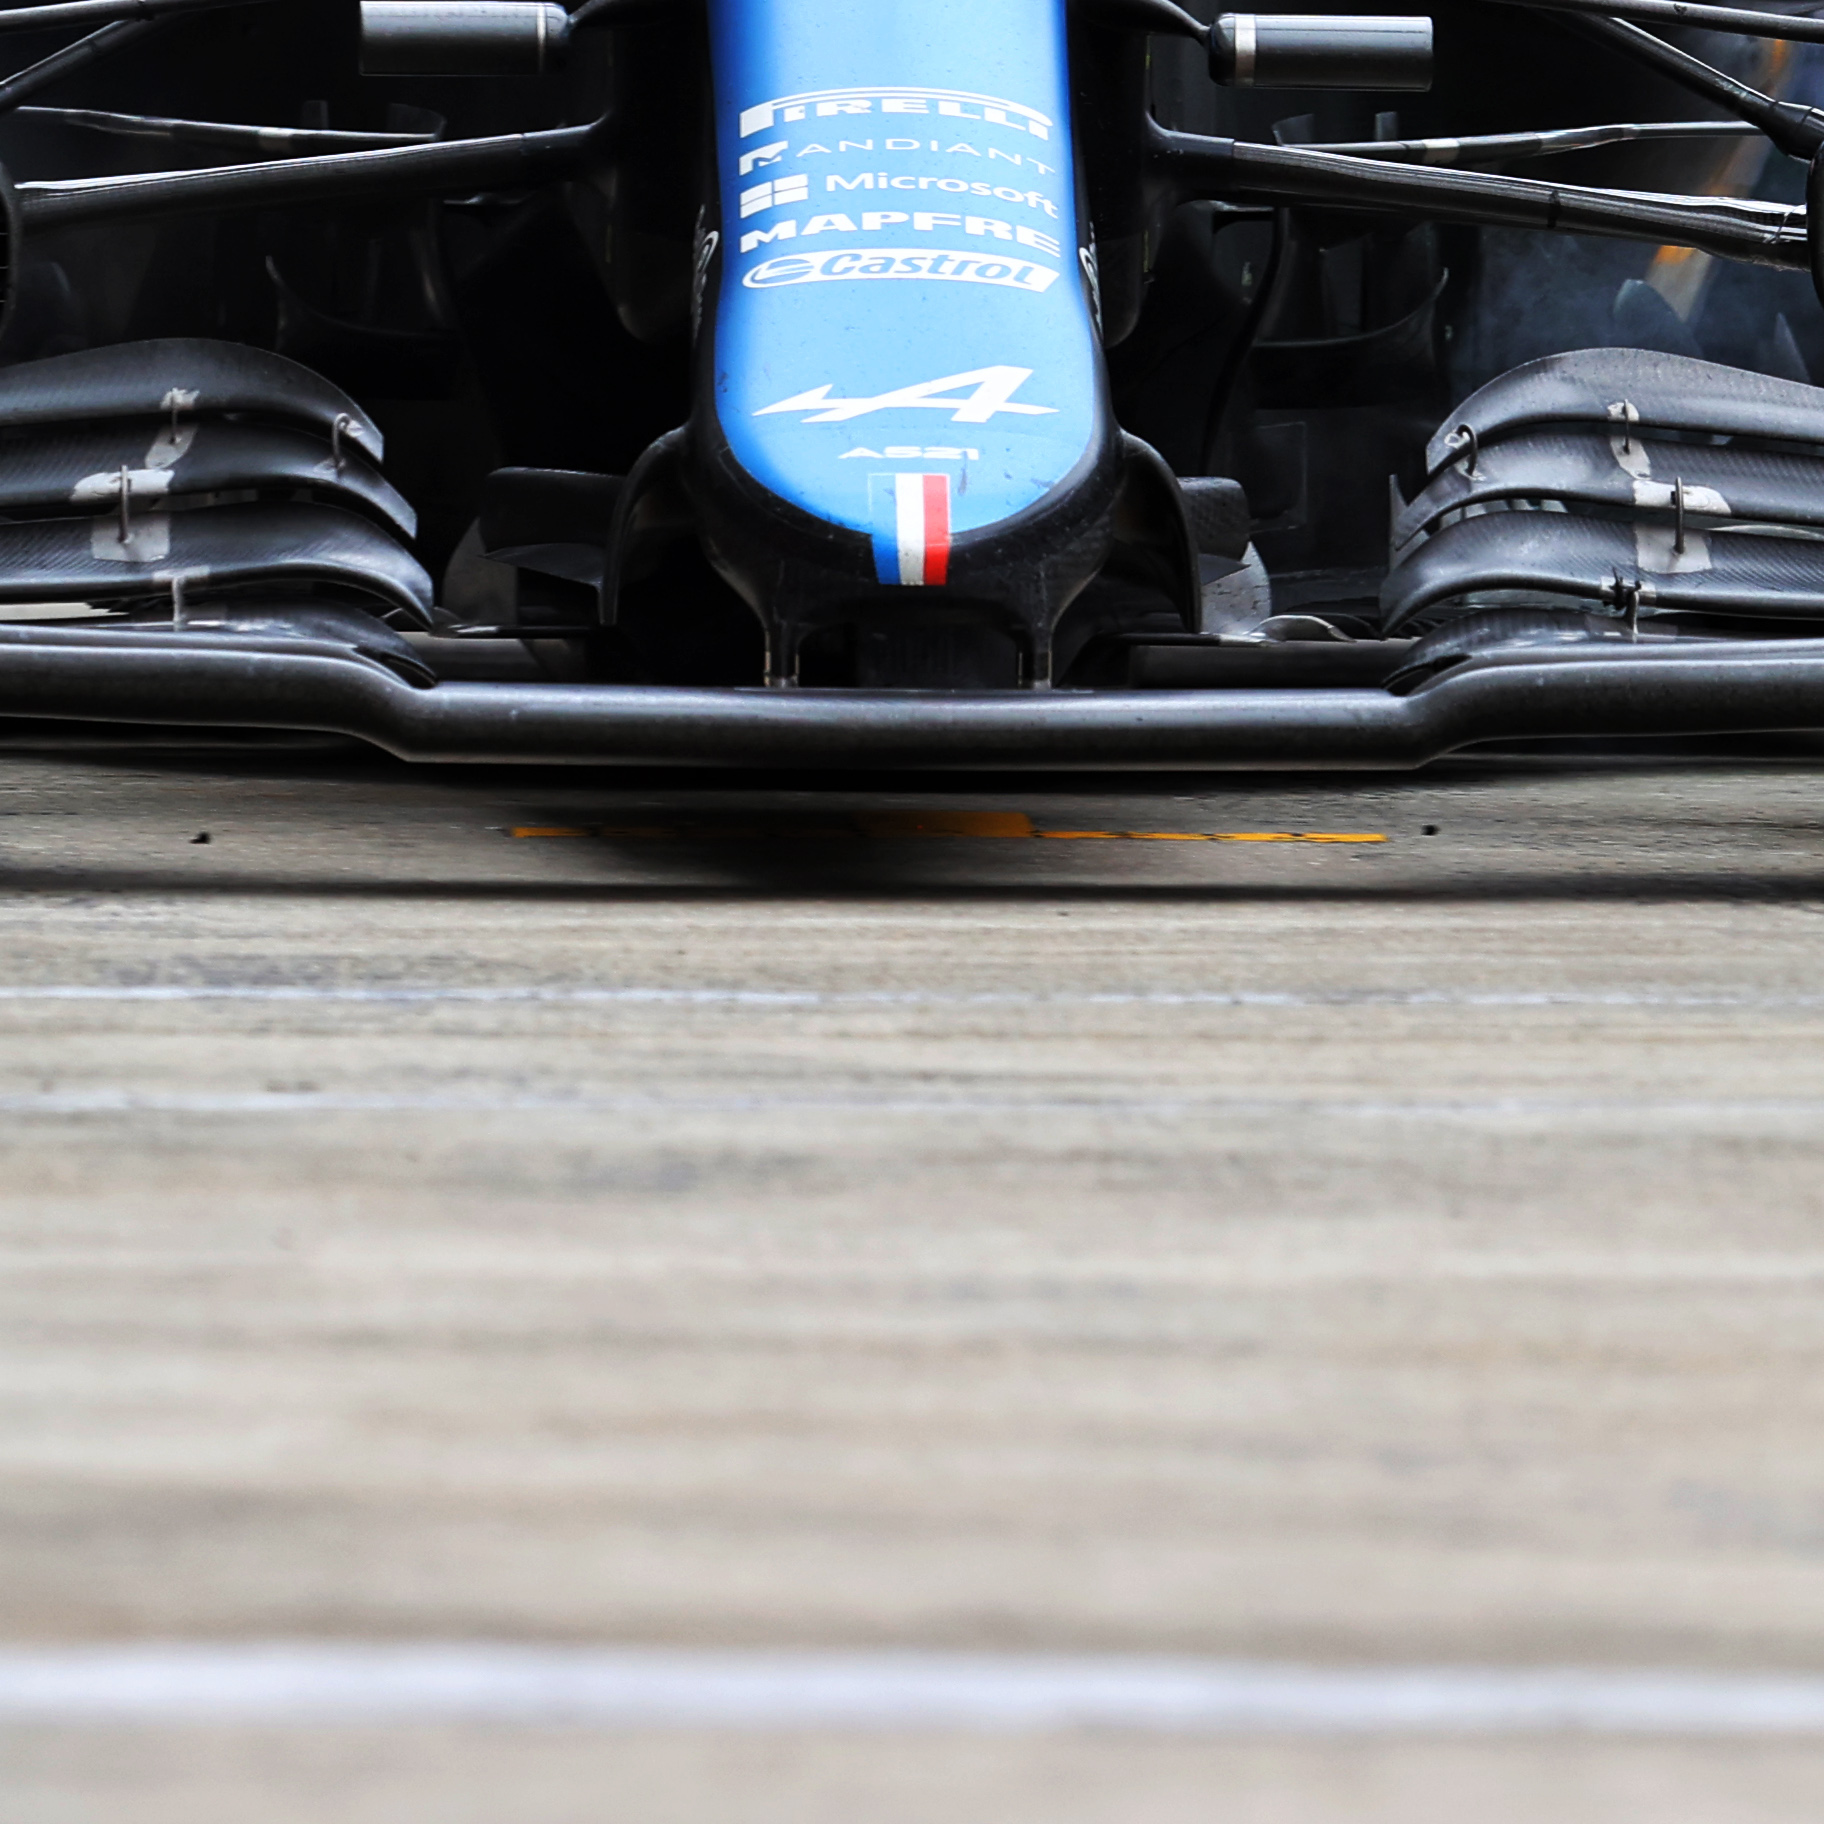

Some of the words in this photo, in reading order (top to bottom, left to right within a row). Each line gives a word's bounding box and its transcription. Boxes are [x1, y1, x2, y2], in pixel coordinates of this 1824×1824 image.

[739, 86, 1054, 141] PIRELLI
[826, 172, 1059, 219] Microsoft
[740, 211, 1061, 258] MAPFRE
[819, 252, 1038, 286] Castrol
[837, 445, 979, 461] A521
